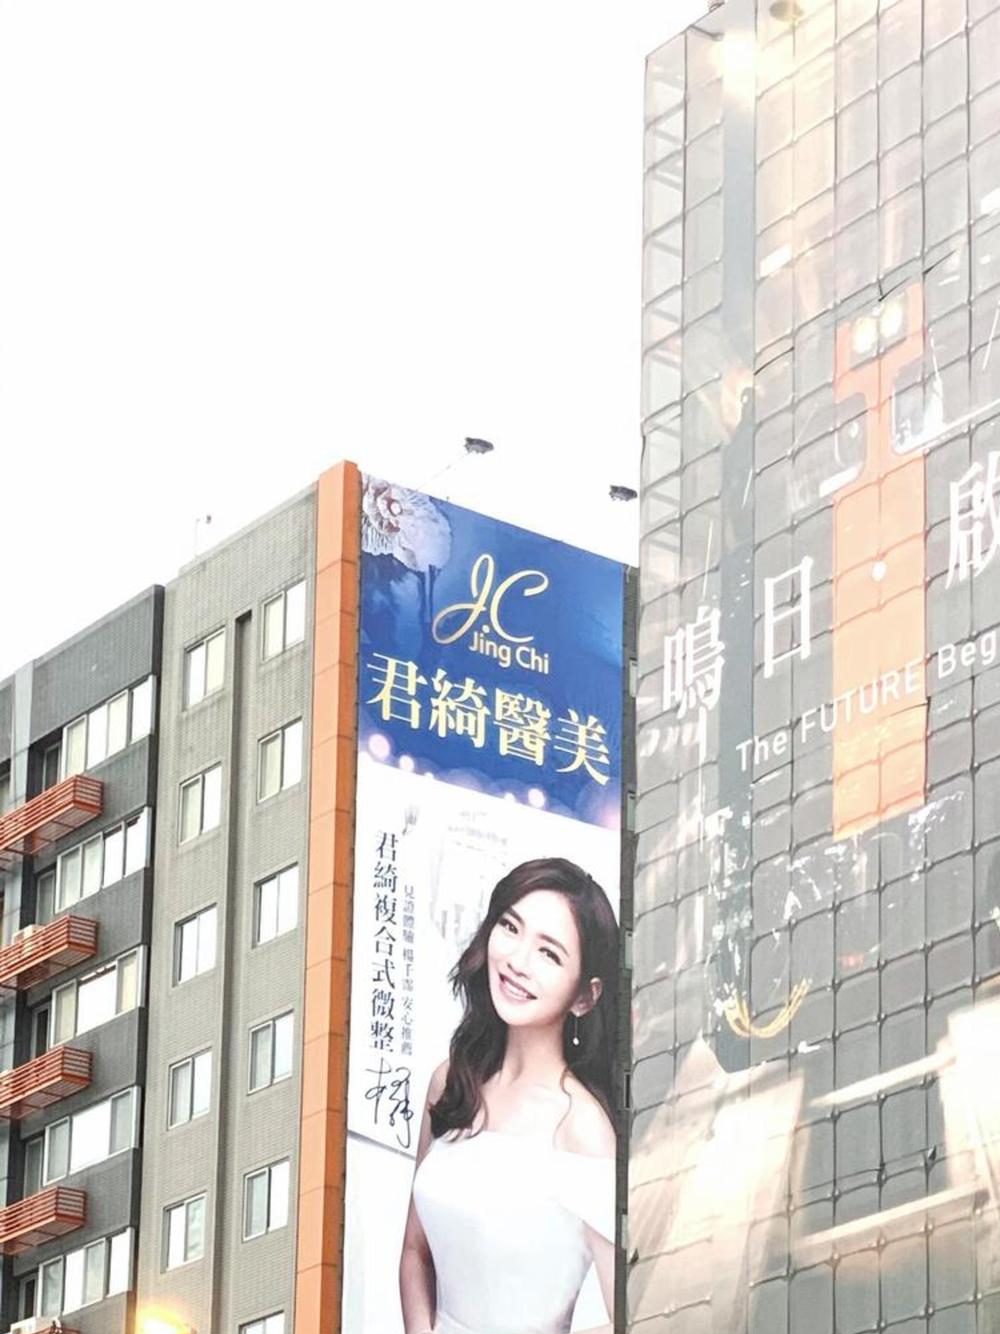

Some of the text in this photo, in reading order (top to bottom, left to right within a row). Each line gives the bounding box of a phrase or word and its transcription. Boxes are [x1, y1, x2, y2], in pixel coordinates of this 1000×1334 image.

[469, 631, 550, 674] Jing Chi
[367, 652, 611, 785] 君綺醫美
[735, 731, 787, 772] The
[800, 668, 923, 744] FUTURE
[369, 830, 399, 1053] 君綺複合式微整
